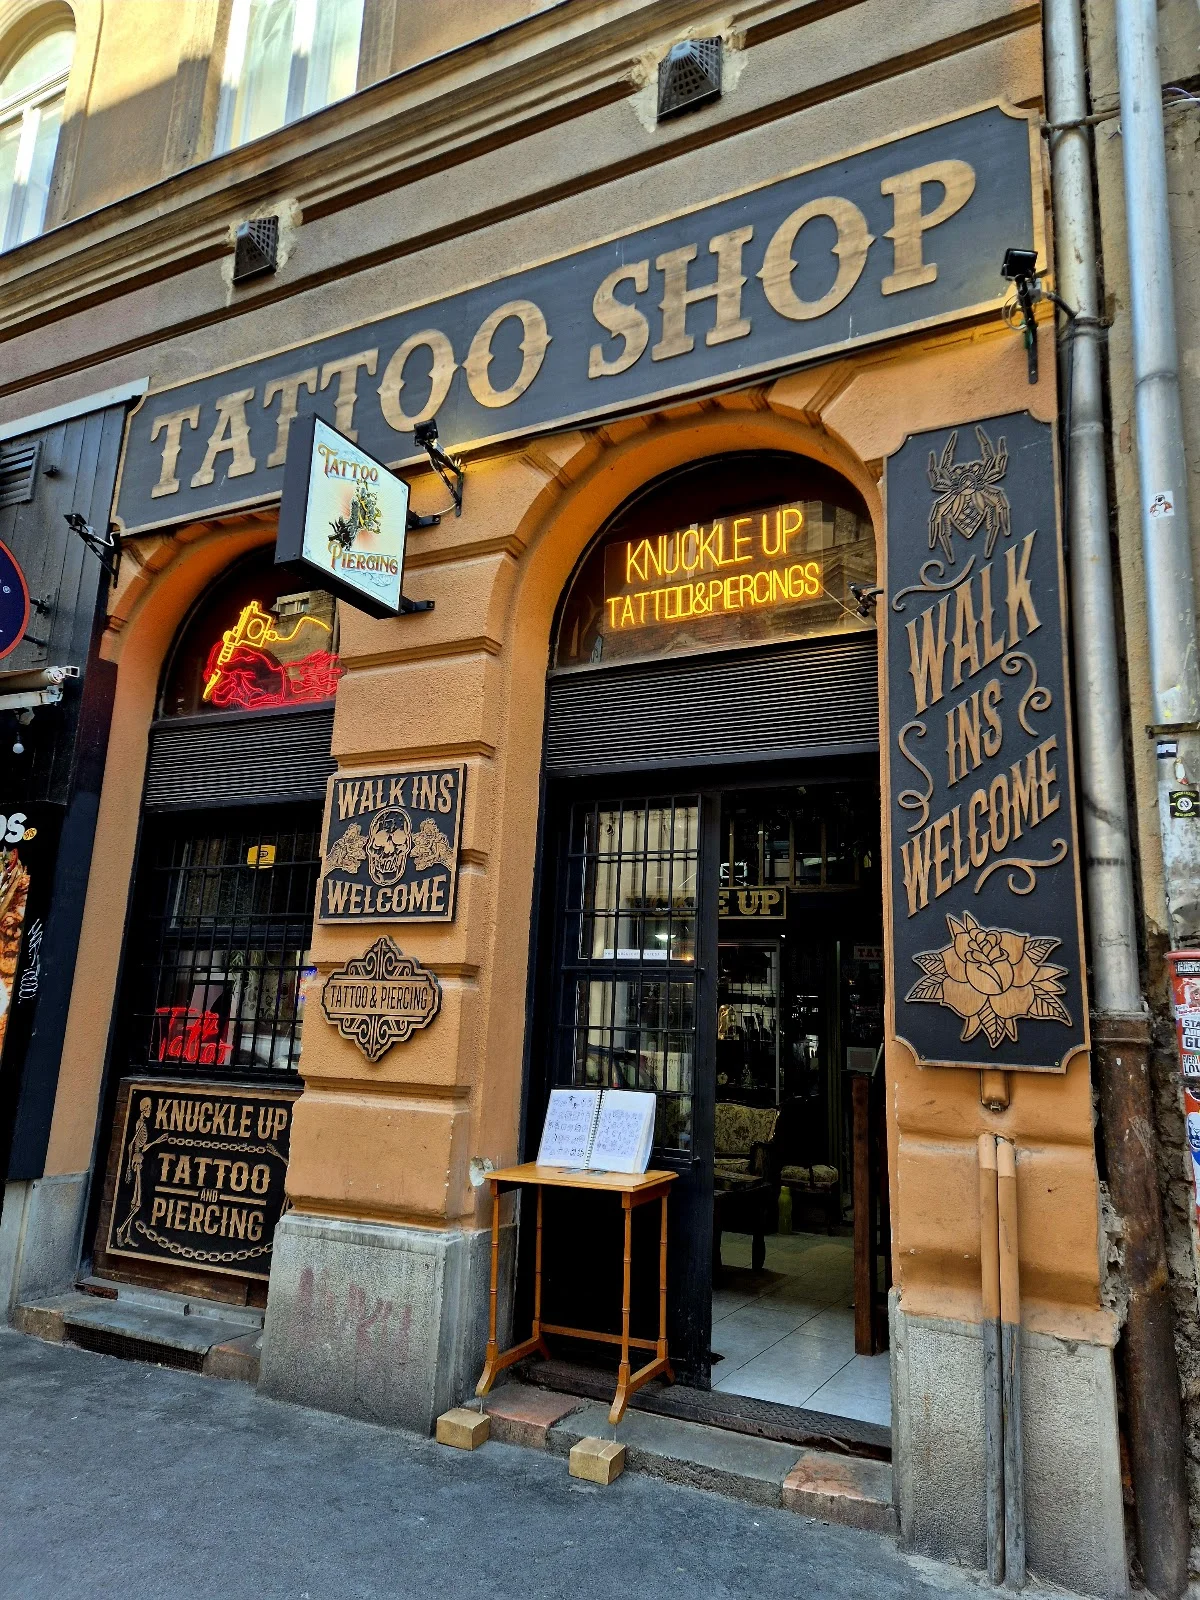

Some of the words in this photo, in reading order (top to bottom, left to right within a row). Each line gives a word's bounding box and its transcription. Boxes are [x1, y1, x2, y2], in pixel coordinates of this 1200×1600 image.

[151, 300, 553, 499] TATTOO
[588, 159, 976, 379] SHOP
[317, 442, 379, 482] TATTOO
[327, 540, 398, 574] PIERCING
[626, 517, 753, 584] KNUCKLE
[762, 508, 803, 555] UP
[905, 529, 1042, 718] WALK
[945, 678, 1005, 788] INS
[337, 776, 408, 821] WALK
[411, 773, 455, 813] INS
[900, 734, 1061, 918] WELCOME
[327, 874, 447, 915] WELCOME
[737, 891, 780, 915] UP
[330, 985, 368, 1009] TATTOO
[369, 985, 377, 1009] &
[380, 986, 428, 1011] PIERCING
[154, 1098, 253, 1138] KNUCKLE
[257, 1106, 288, 1141] UP
[157, 1152, 271, 1194] TATTOO
[199, 1188, 219, 1203] AND
[150, 1197, 264, 1242] PIERCING
